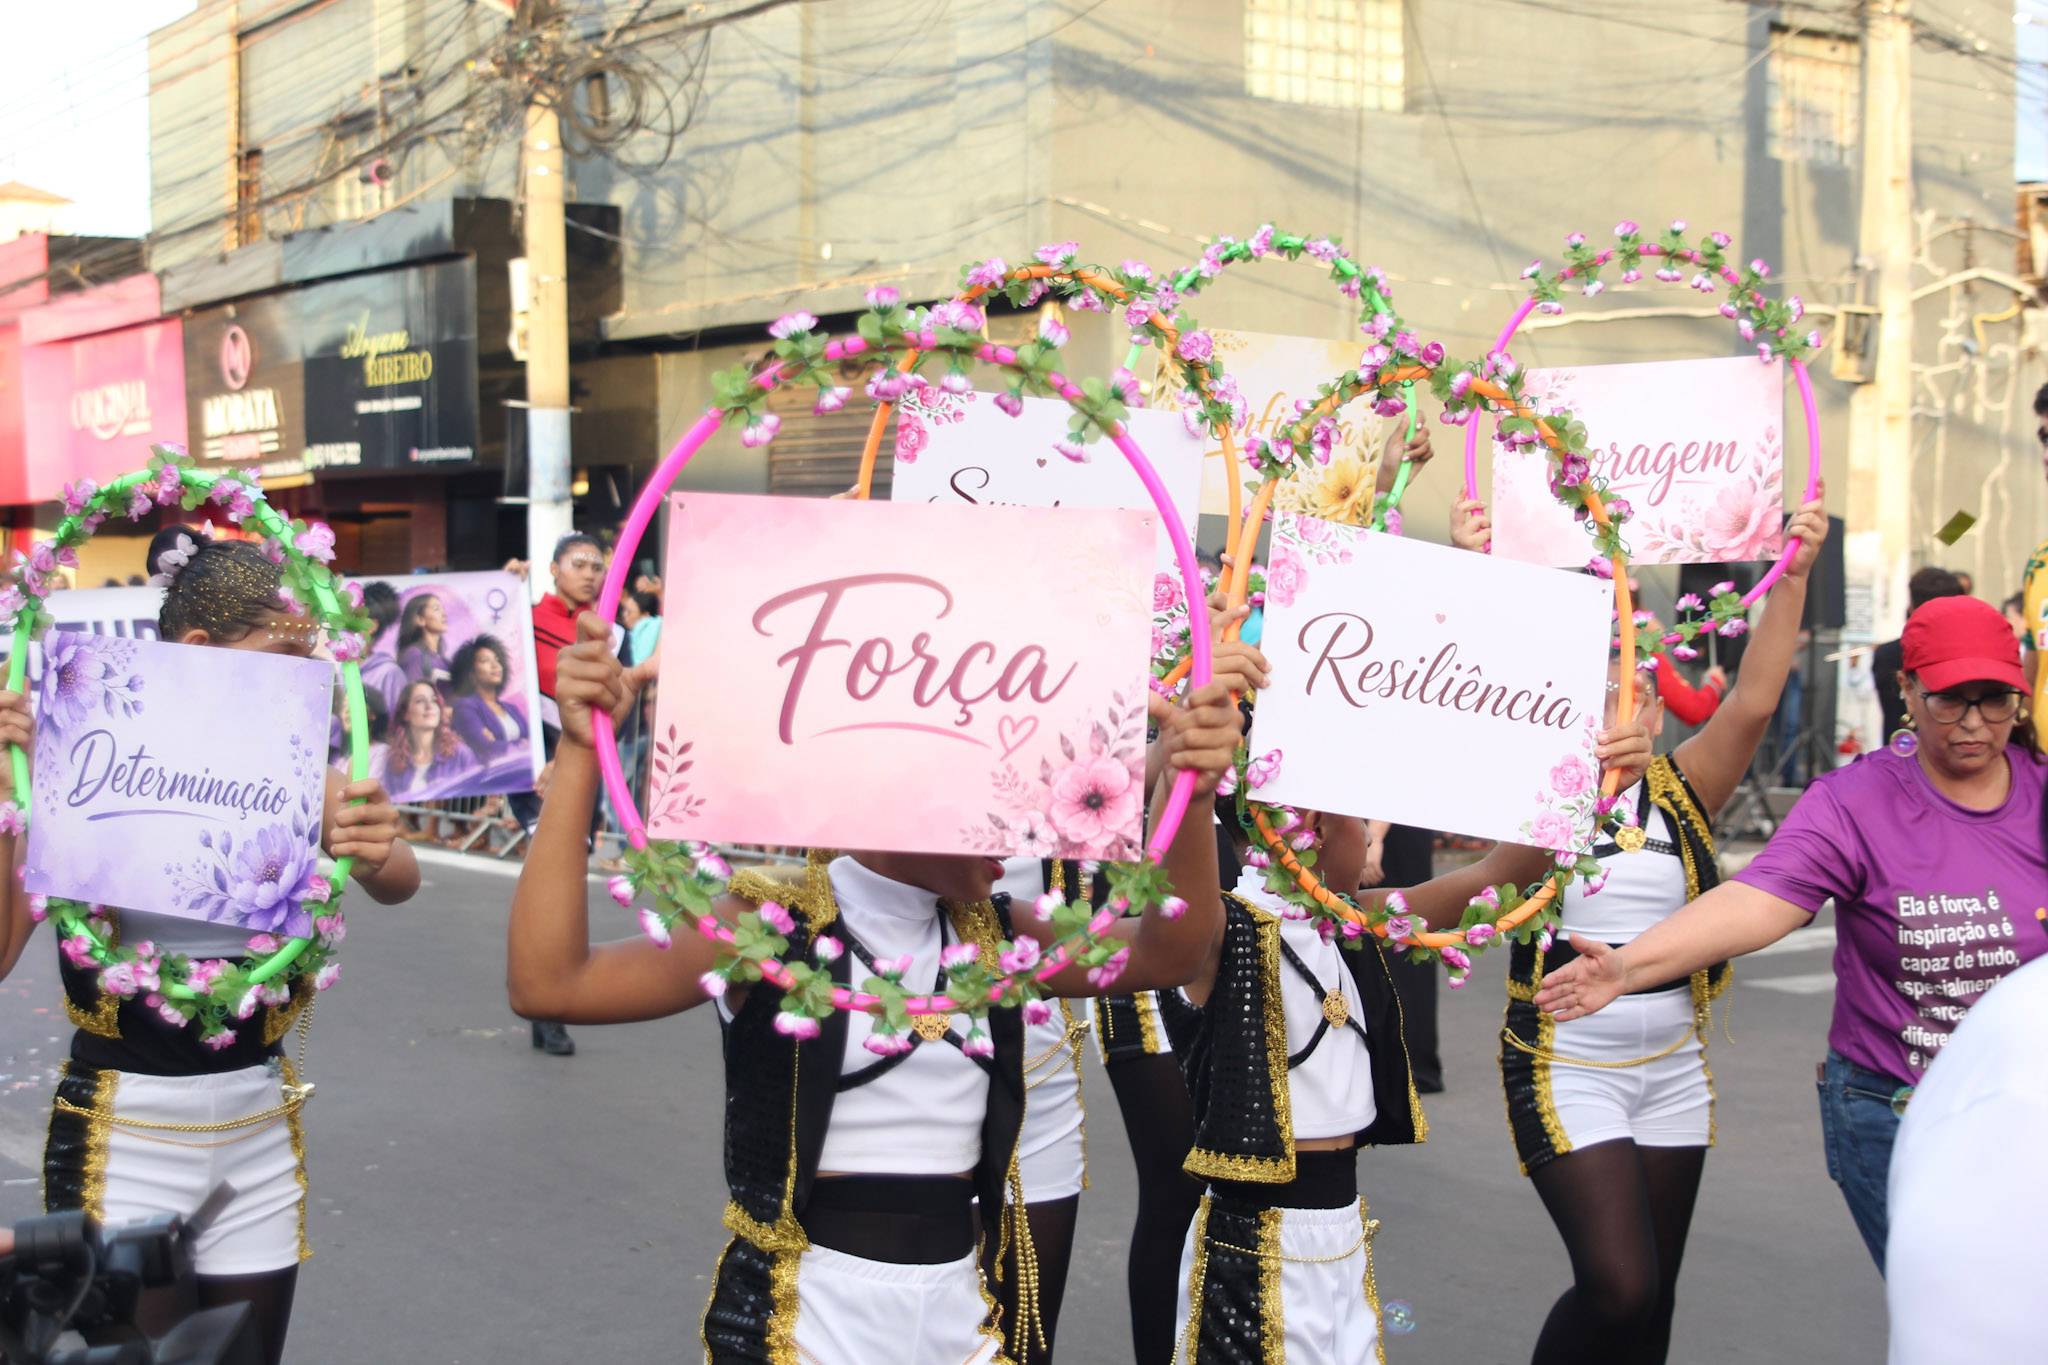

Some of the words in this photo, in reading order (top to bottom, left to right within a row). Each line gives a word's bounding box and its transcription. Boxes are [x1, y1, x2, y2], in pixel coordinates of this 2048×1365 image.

[364, 350, 433, 387] RIBEIRO
[1546, 440, 1746, 507] oragem
[751, 572, 1079, 746] Força
[1297, 612, 1581, 730] Resiliência
[67, 729, 292, 820] Determinação
[1898, 895, 1926, 917] Ela
[1928, 894, 1939, 915] é
[1940, 894, 1987, 917] força,
[1987, 890, 1999, 911] é
[1898, 921, 1986, 950] inspiração
[1988, 922, 2000, 938] e
[2001, 916, 2014, 937] é
[1900, 956, 1950, 976] capaz
[1953, 950, 1974, 969] de
[1977, 945, 2020, 967] tudo,
[1901, 1026, 1955, 1047] difere
